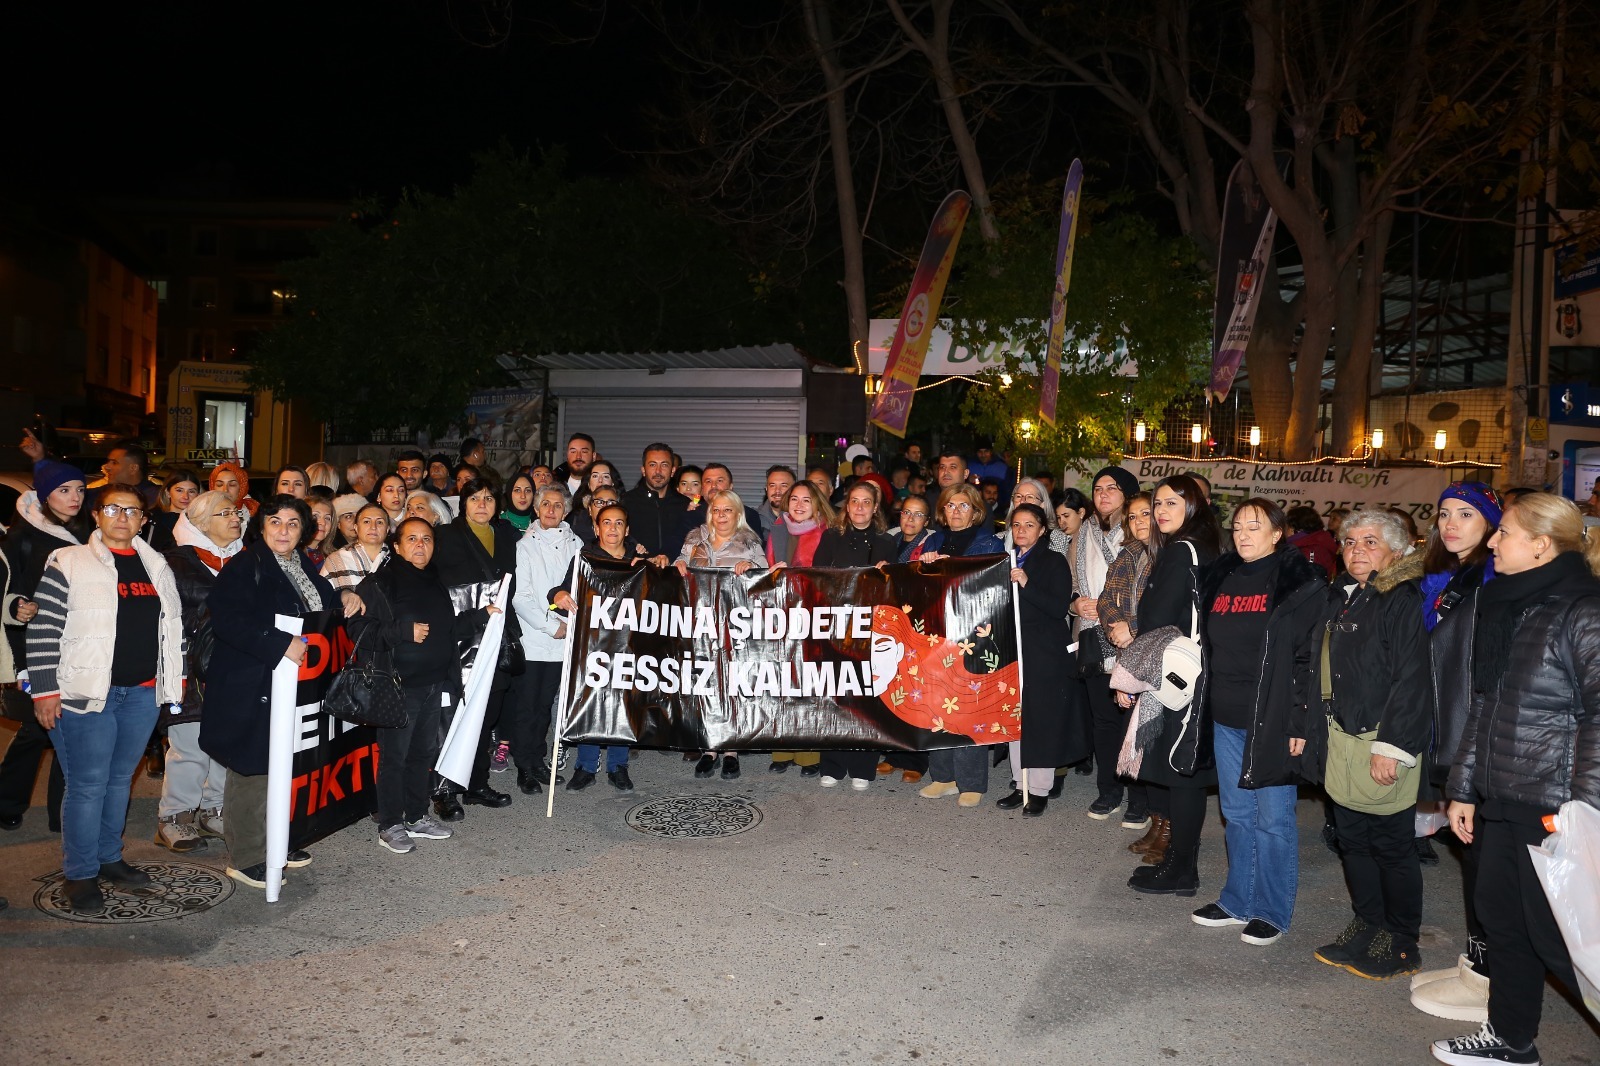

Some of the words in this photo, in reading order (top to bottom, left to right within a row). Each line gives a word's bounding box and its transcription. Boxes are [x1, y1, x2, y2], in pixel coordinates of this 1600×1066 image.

[1224, 465, 1246, 480] de
[1251, 465, 1333, 483] Kahvaltı
[1338, 468, 1390, 488] Keyfi
[1254, 486, 1300, 495] Rezervasyon
[1408, 503, 1433, 520] 78
[1231, 594, 1267, 613] SENDE
[590, 595, 718, 640] KADINA
[729, 599, 871, 649] ŞİDDETE
[585, 651, 715, 696] SESSİZ
[729, 660, 873, 697] KALMA!
